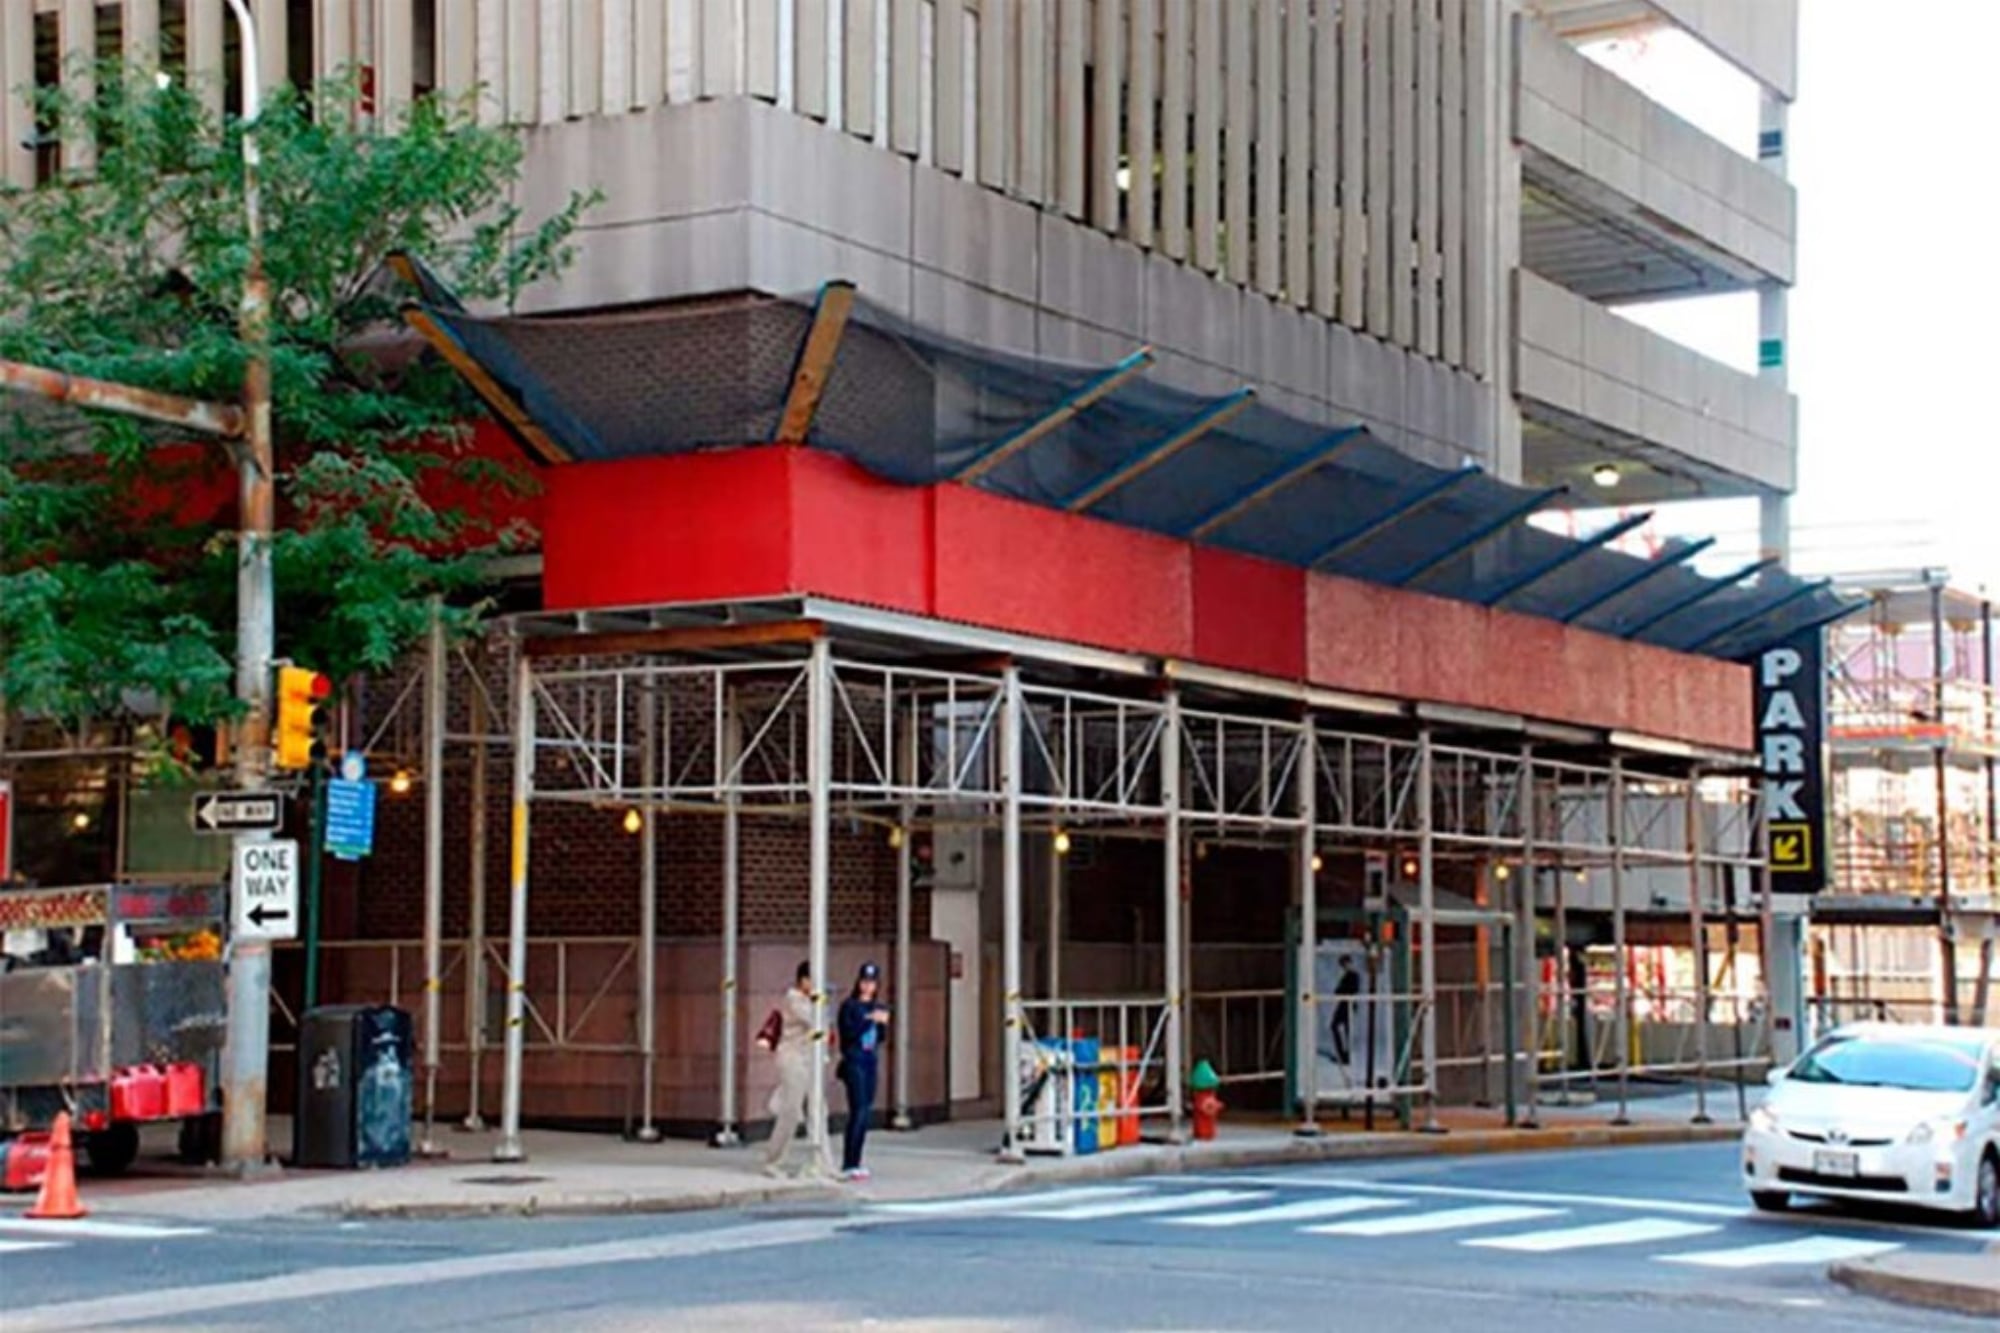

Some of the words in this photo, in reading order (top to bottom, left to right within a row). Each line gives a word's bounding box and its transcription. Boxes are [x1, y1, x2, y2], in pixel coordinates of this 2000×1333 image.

[1761, 648, 1806, 819] PARK
[245, 850, 289, 871] ONE
[246, 877, 289, 895] WAY
